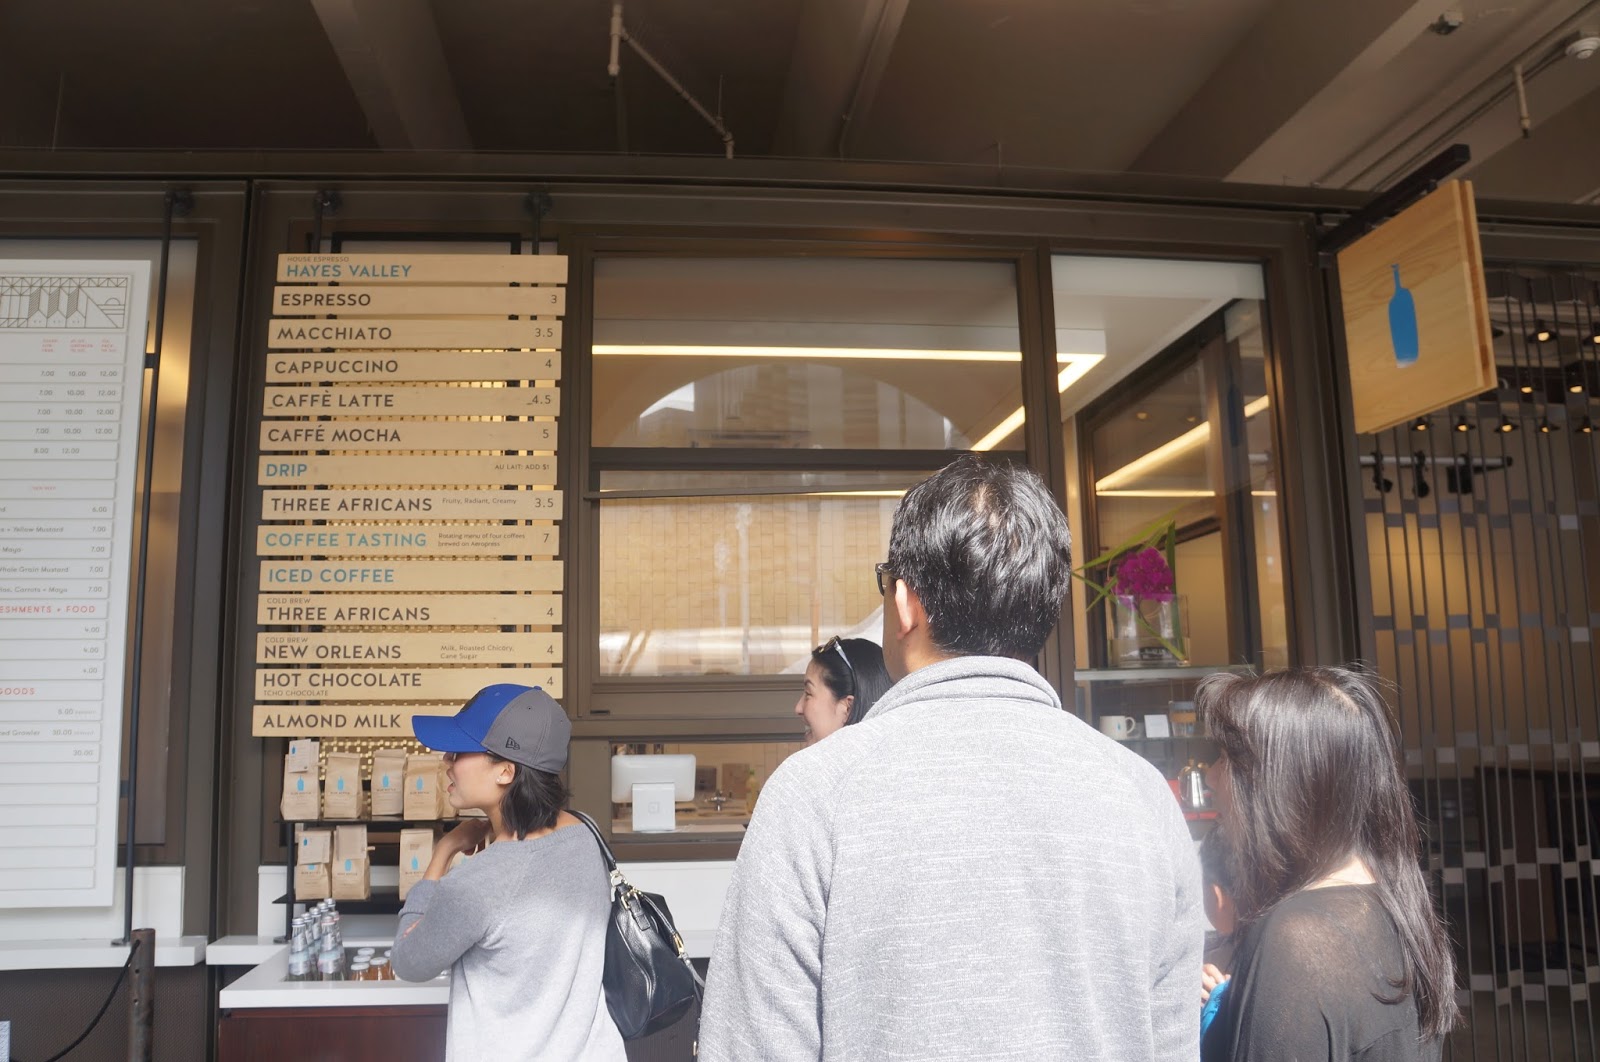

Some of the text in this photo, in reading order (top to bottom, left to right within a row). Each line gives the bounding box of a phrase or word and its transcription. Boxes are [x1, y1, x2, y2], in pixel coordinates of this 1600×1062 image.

[286, 265, 412, 278] HAYES VALLEY
[280, 294, 371, 306] ESPRESSO
[551, 295, 557, 304] 3
[277, 327, 392, 340] MACCHIATO
[534, 328, 553, 338] 3.5
[274, 360, 398, 374] CAPPUCCINO
[545, 359, 552, 368] 4
[272, 390, 394, 407] CAFFÈ LATTE
[532, 395, 551, 405] 4.5
[267, 425, 401, 442] CAFFÉ MOCHA
[542, 429, 549, 439] 5
[265, 463, 307, 477] DRIP
[270, 498, 432, 511] THREE AFRICANS
[534, 498, 554, 508] 3.5
[265, 533, 427, 547] COFFEE TASTING
[542, 533, 550, 543] 7
[268, 569, 394, 583] ICED COFFEE
[267, 607, 430, 621] THREE AFRICANS
[546, 608, 554, 617] 4
[264, 646, 401, 659] NEW ORLEANS
[546, 645, 554, 655] 4
[458, 653, 477, 661] Sugar
[263, 673, 422, 687] HOT CHOCOLATE
[546, 676, 554, 686] 4
[263, 714, 401, 728] ALMOND MILK
